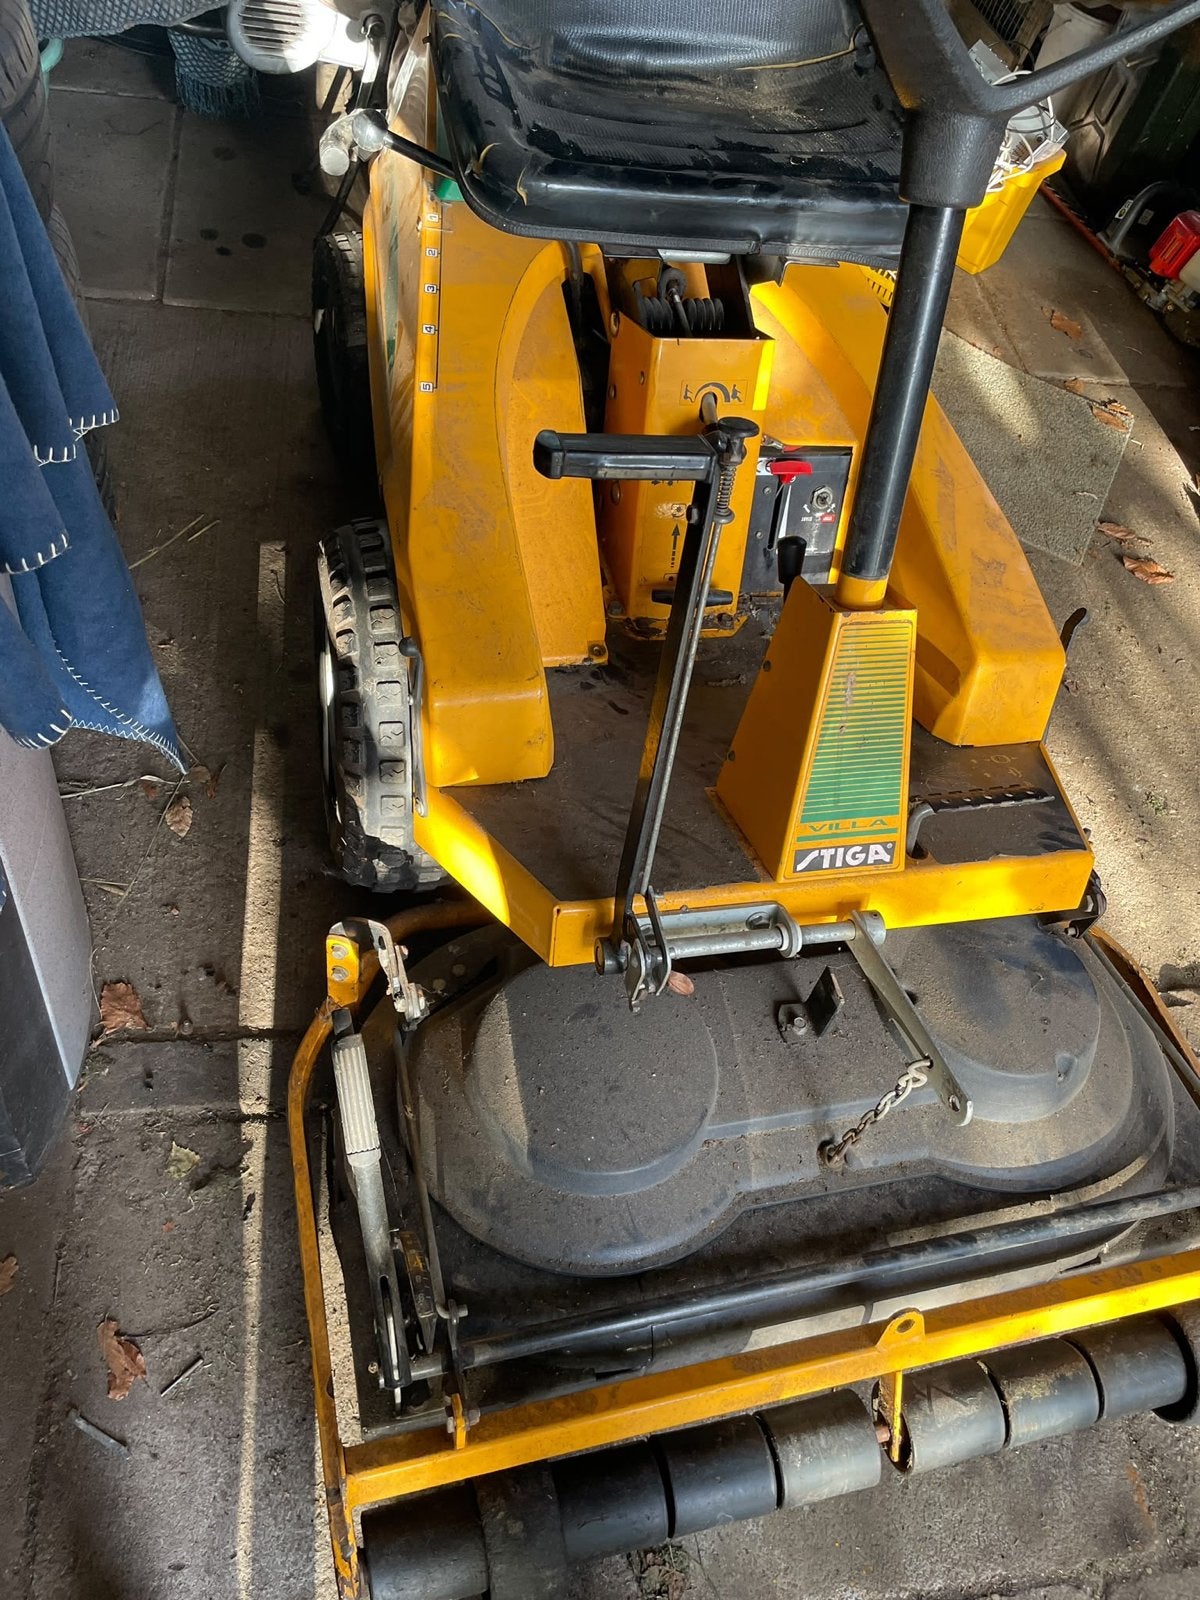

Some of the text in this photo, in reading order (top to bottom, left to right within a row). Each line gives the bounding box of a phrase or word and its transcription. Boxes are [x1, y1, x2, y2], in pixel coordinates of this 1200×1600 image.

[428, 213, 438, 221] 1
[427, 248, 437, 257] 2
[422, 383, 432, 391] 5
[808, 818, 888, 832] VILLA
[796, 844, 890, 871] STIGA
